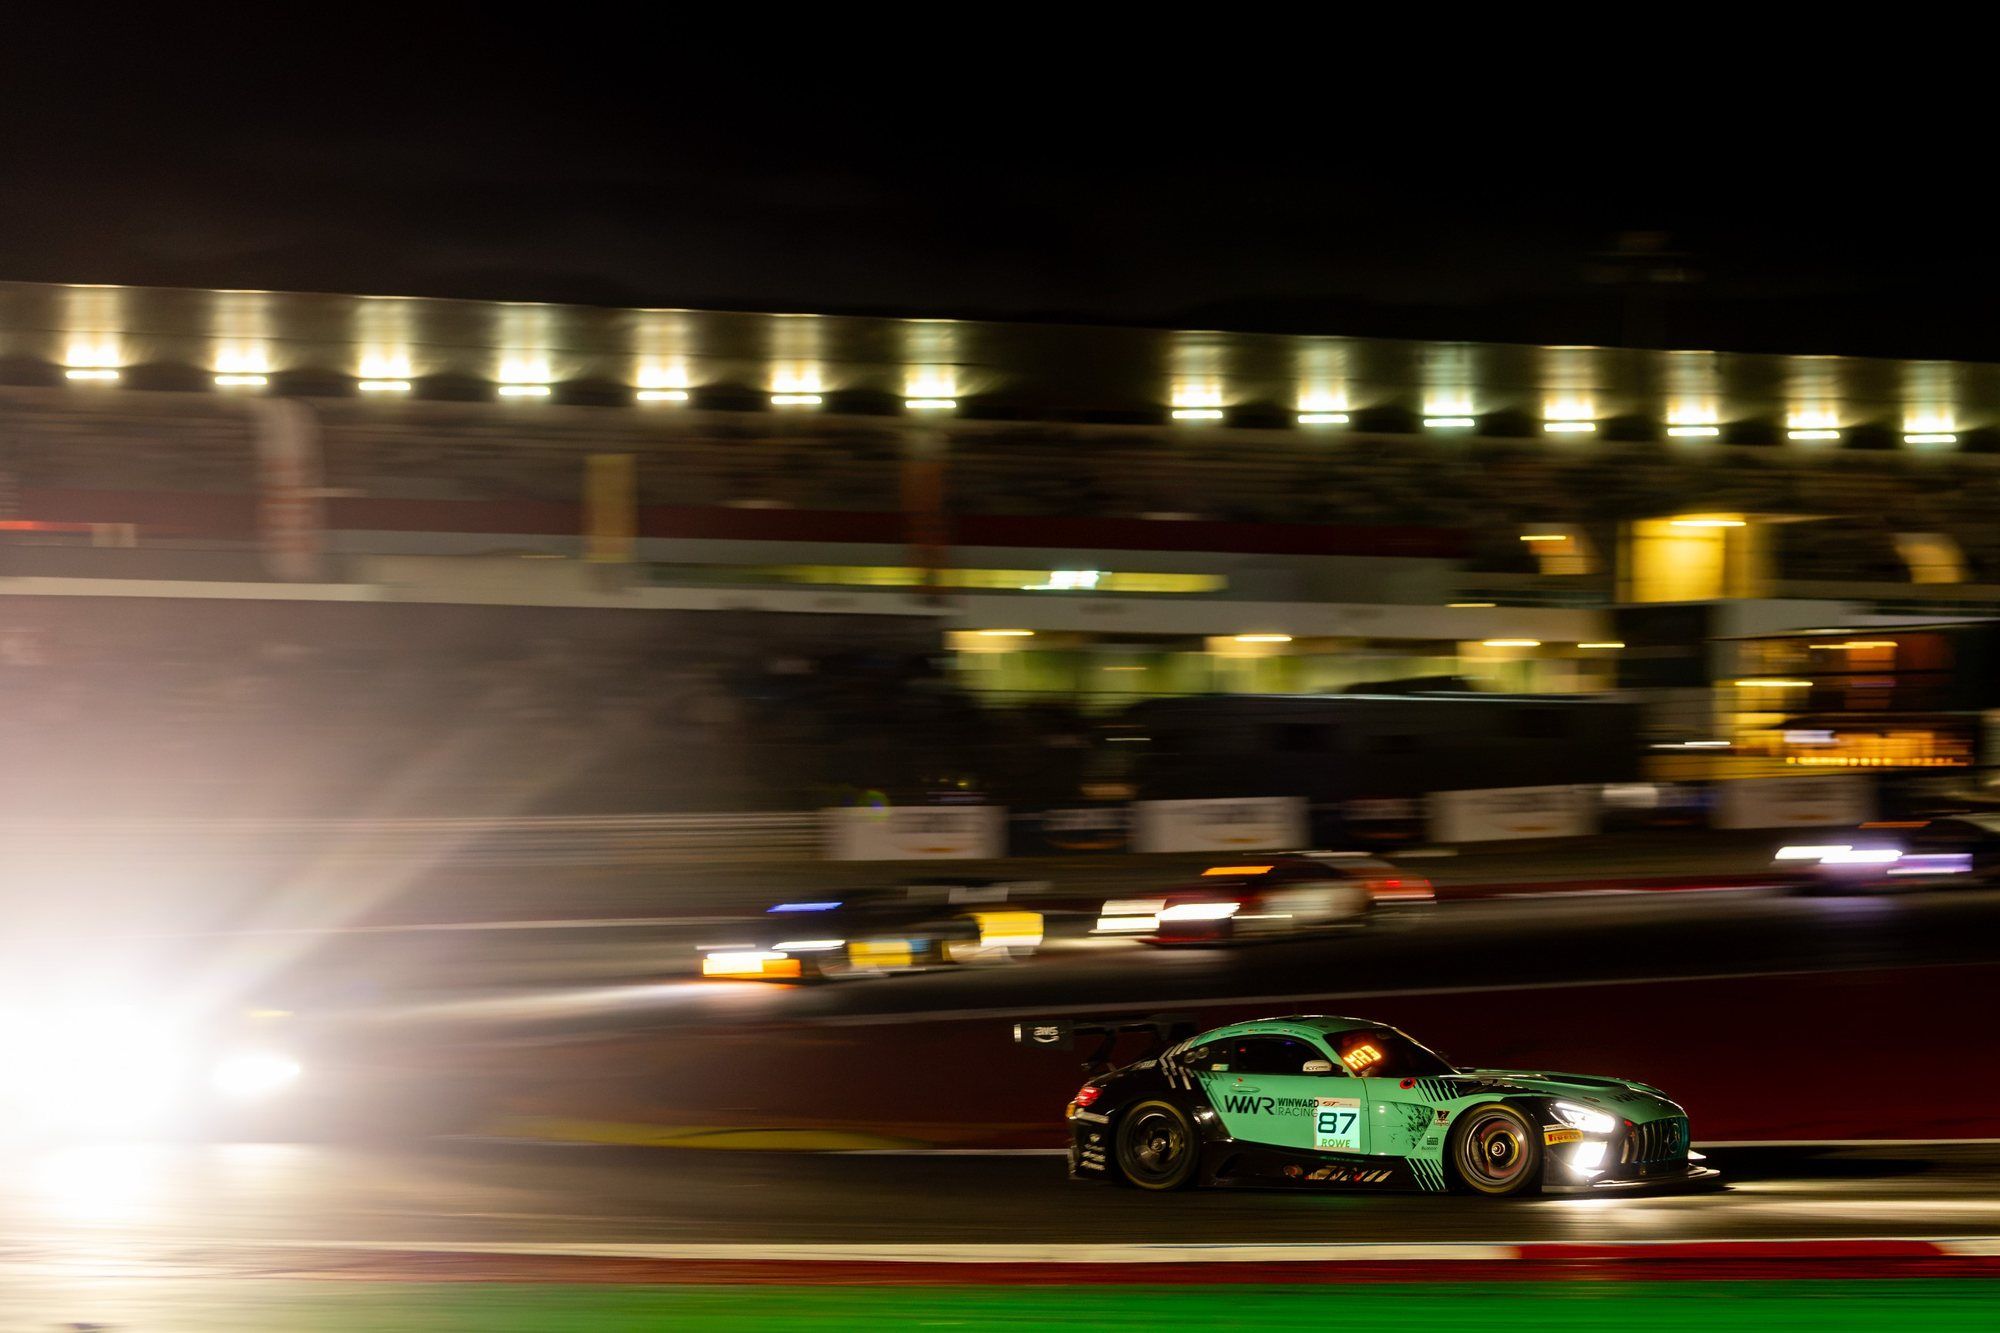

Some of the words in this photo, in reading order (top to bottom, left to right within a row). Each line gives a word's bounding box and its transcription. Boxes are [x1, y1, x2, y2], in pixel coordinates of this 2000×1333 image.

[1277, 1098, 1319, 1108] WINWARD
[1277, 1107, 1319, 1117] RACING
[1318, 1112, 1357, 1134] 87
[1321, 1138, 1351, 1147] ROWE
